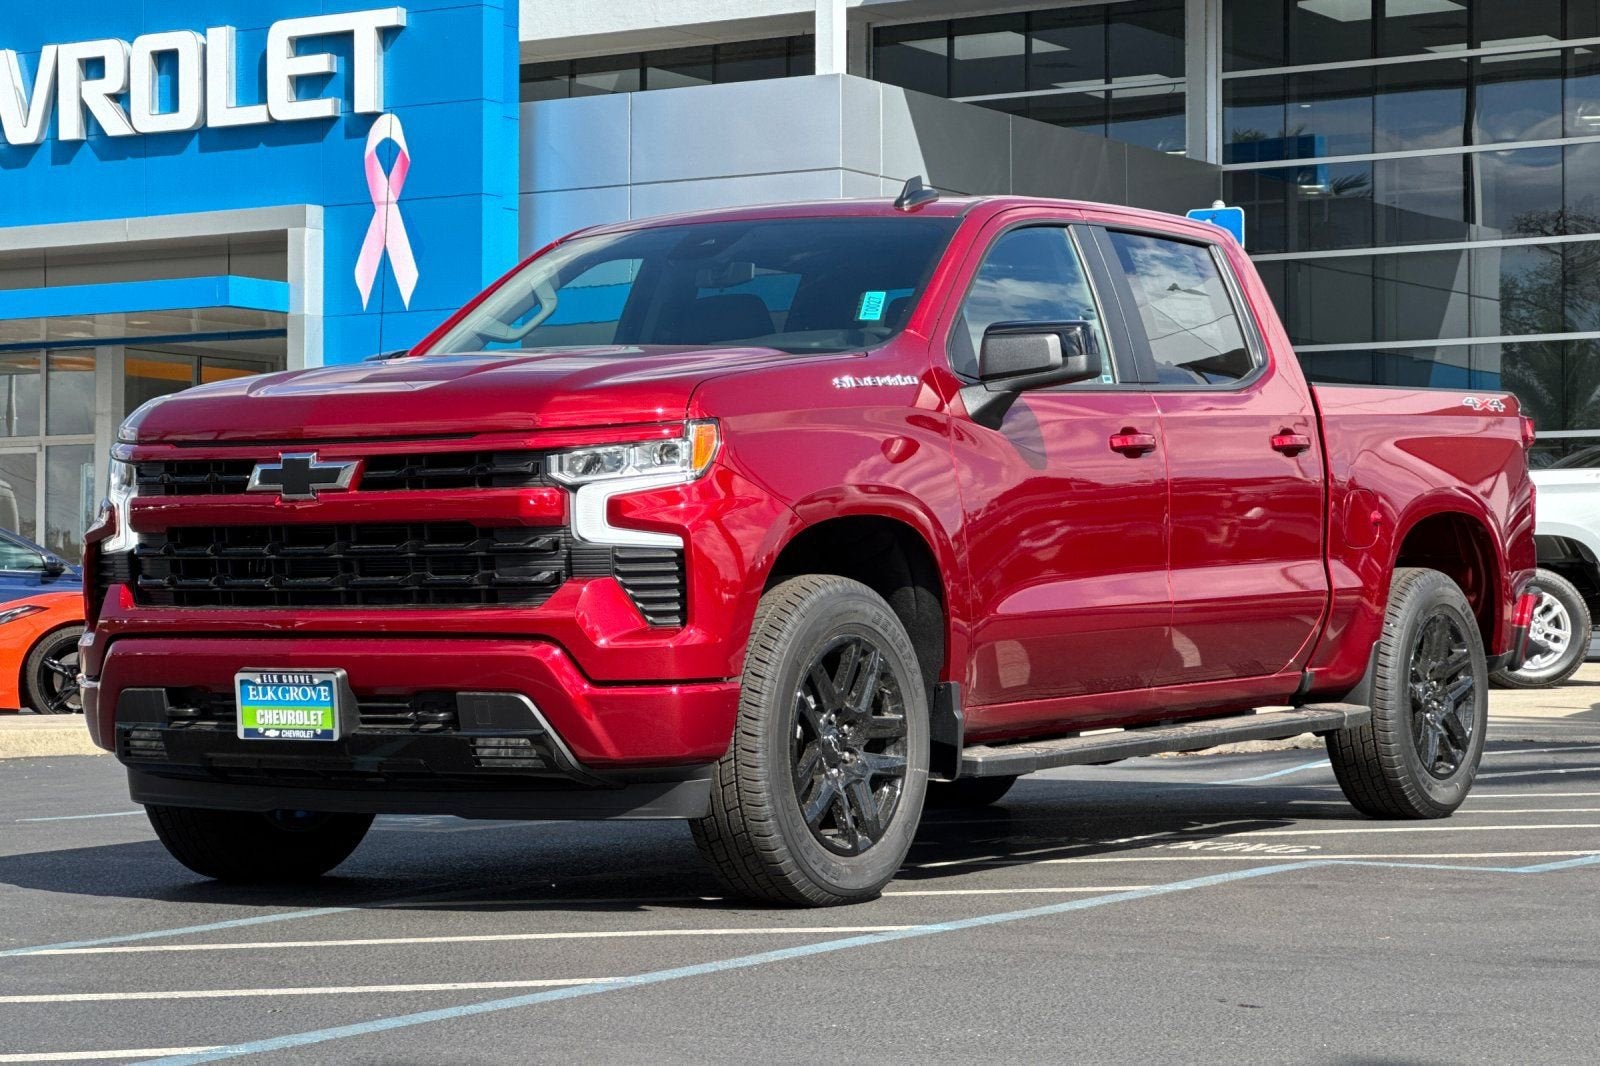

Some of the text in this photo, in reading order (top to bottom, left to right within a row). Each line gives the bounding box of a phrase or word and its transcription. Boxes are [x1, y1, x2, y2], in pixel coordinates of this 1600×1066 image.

[262, 674, 311, 684] ELK GROVE
[248, 686, 330, 701] ELK GROVE
[256, 709, 324, 727] CHEVROLET
[281, 729, 314, 739] CHEVROLET
